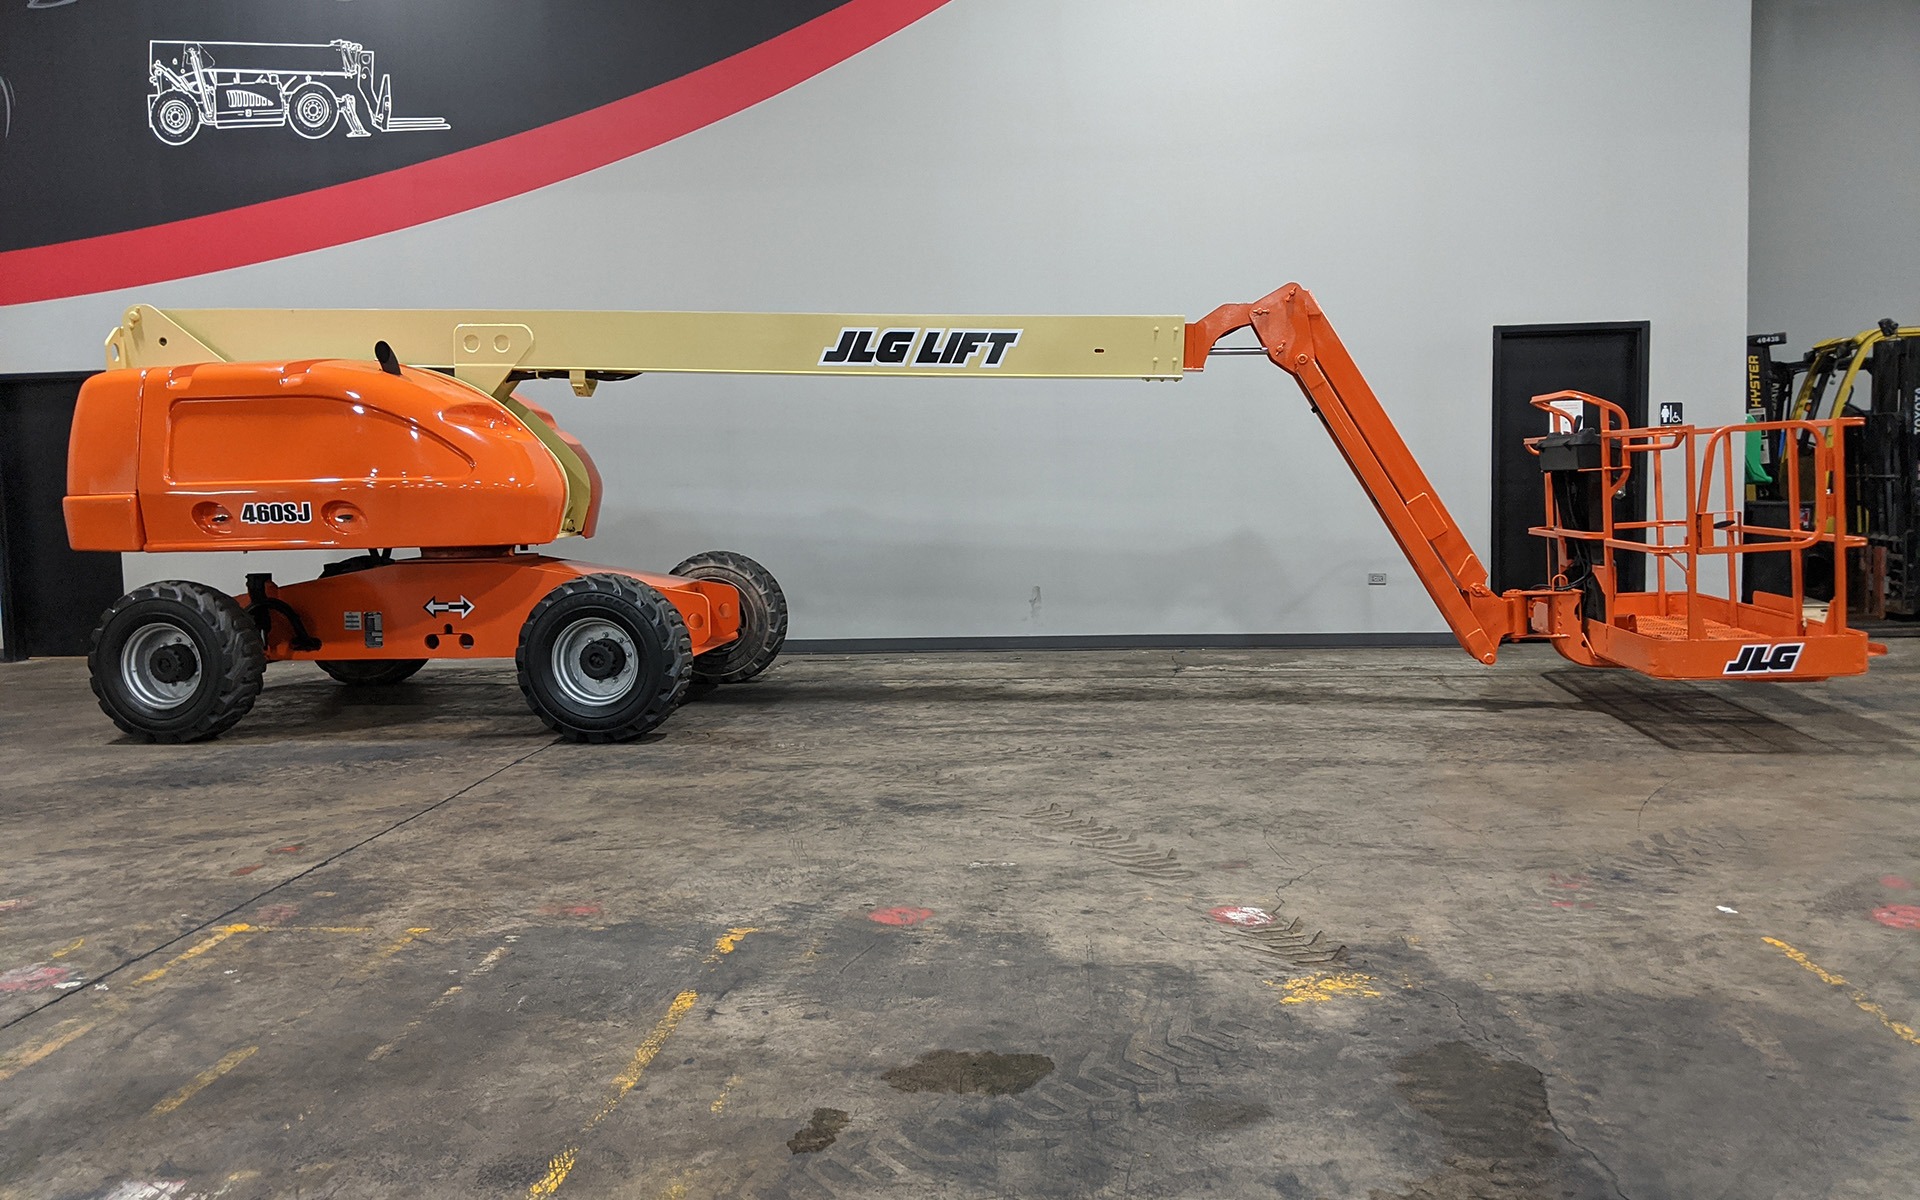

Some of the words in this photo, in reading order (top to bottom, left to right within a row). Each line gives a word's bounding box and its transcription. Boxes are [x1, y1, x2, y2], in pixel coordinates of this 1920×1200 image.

[818, 328, 919, 366] JLG
[911, 329, 1022, 367] LIFT
[1748, 355, 1761, 408] HYSTER
[241, 502, 311, 524] 460SJ
[1724, 643, 1804, 674] JLG
